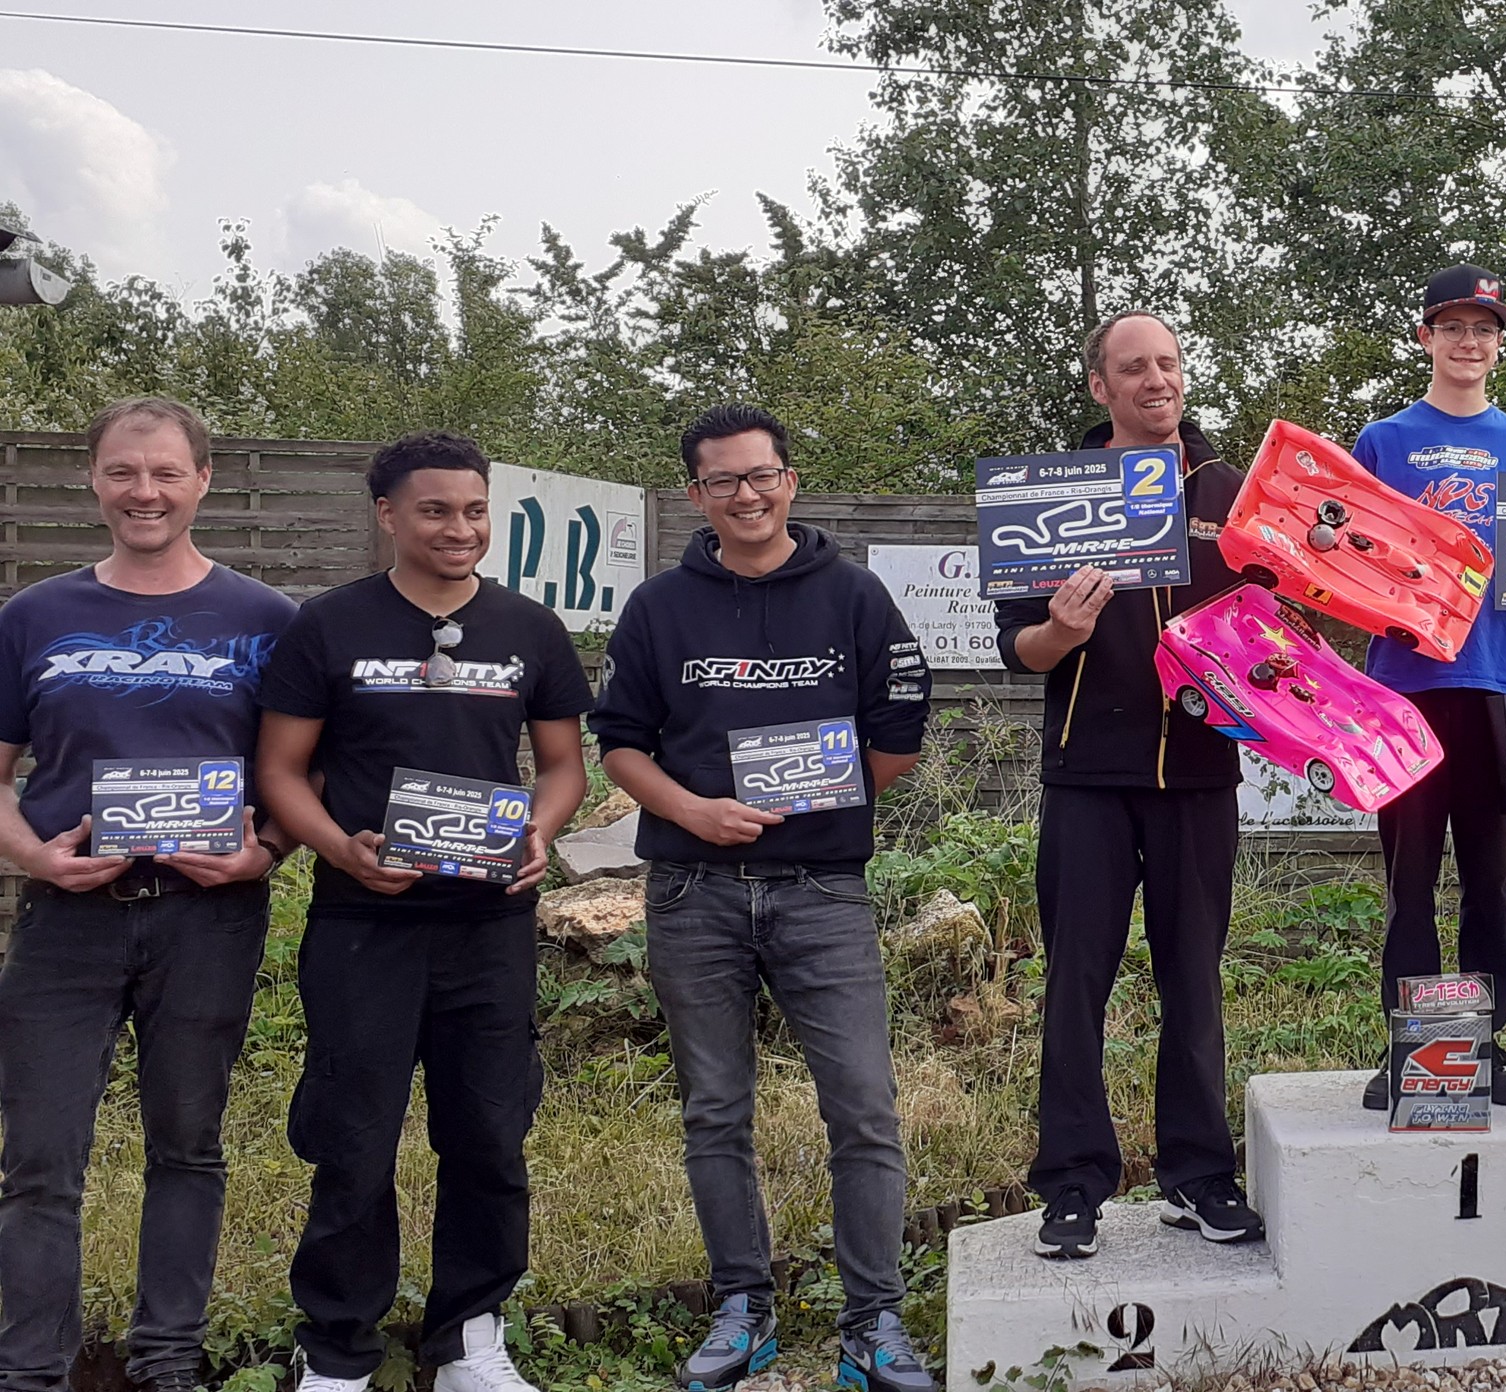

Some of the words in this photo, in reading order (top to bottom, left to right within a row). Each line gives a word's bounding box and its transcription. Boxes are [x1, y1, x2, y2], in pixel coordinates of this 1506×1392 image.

[1039, 466, 1062, 477] 6-7-8
[1063, 465, 1082, 476] juin
[1083, 463, 1106, 474] 2025
[1130, 458, 1166, 496] 2
[981, 491, 1029, 503] Championnat
[1040, 488, 1064, 496] France
[1070, 485, 1111, 495] Ris-Orangis
[1031, 562, 1080, 572] RACING
[904, 584, 972, 598] Peinture
[932, 622, 957, 630] Lardy
[965, 622, 992, 630] 91790
[936, 636, 958, 650] 01
[969, 636, 994, 650] 60
[38, 650, 235, 681] XRAY
[926, 656, 950, 664] ALIBAT
[90, 675, 176, 684] RACING
[178, 678, 233, 690] TEAM
[700, 680, 730, 688] WORLD
[824, 730, 848, 750] 11
[204, 770, 236, 790] 12
[452, 788, 466, 797] juin
[494, 799, 524, 819] 10
[1412, 1104, 1469, 1113] FLYING
[1413, 1114, 1432, 1122] TO
[1437, 1114, 1468, 1122] WIN
[1454, 1153, 1482, 1220] 1
[1107, 1302, 1156, 1372] 2
